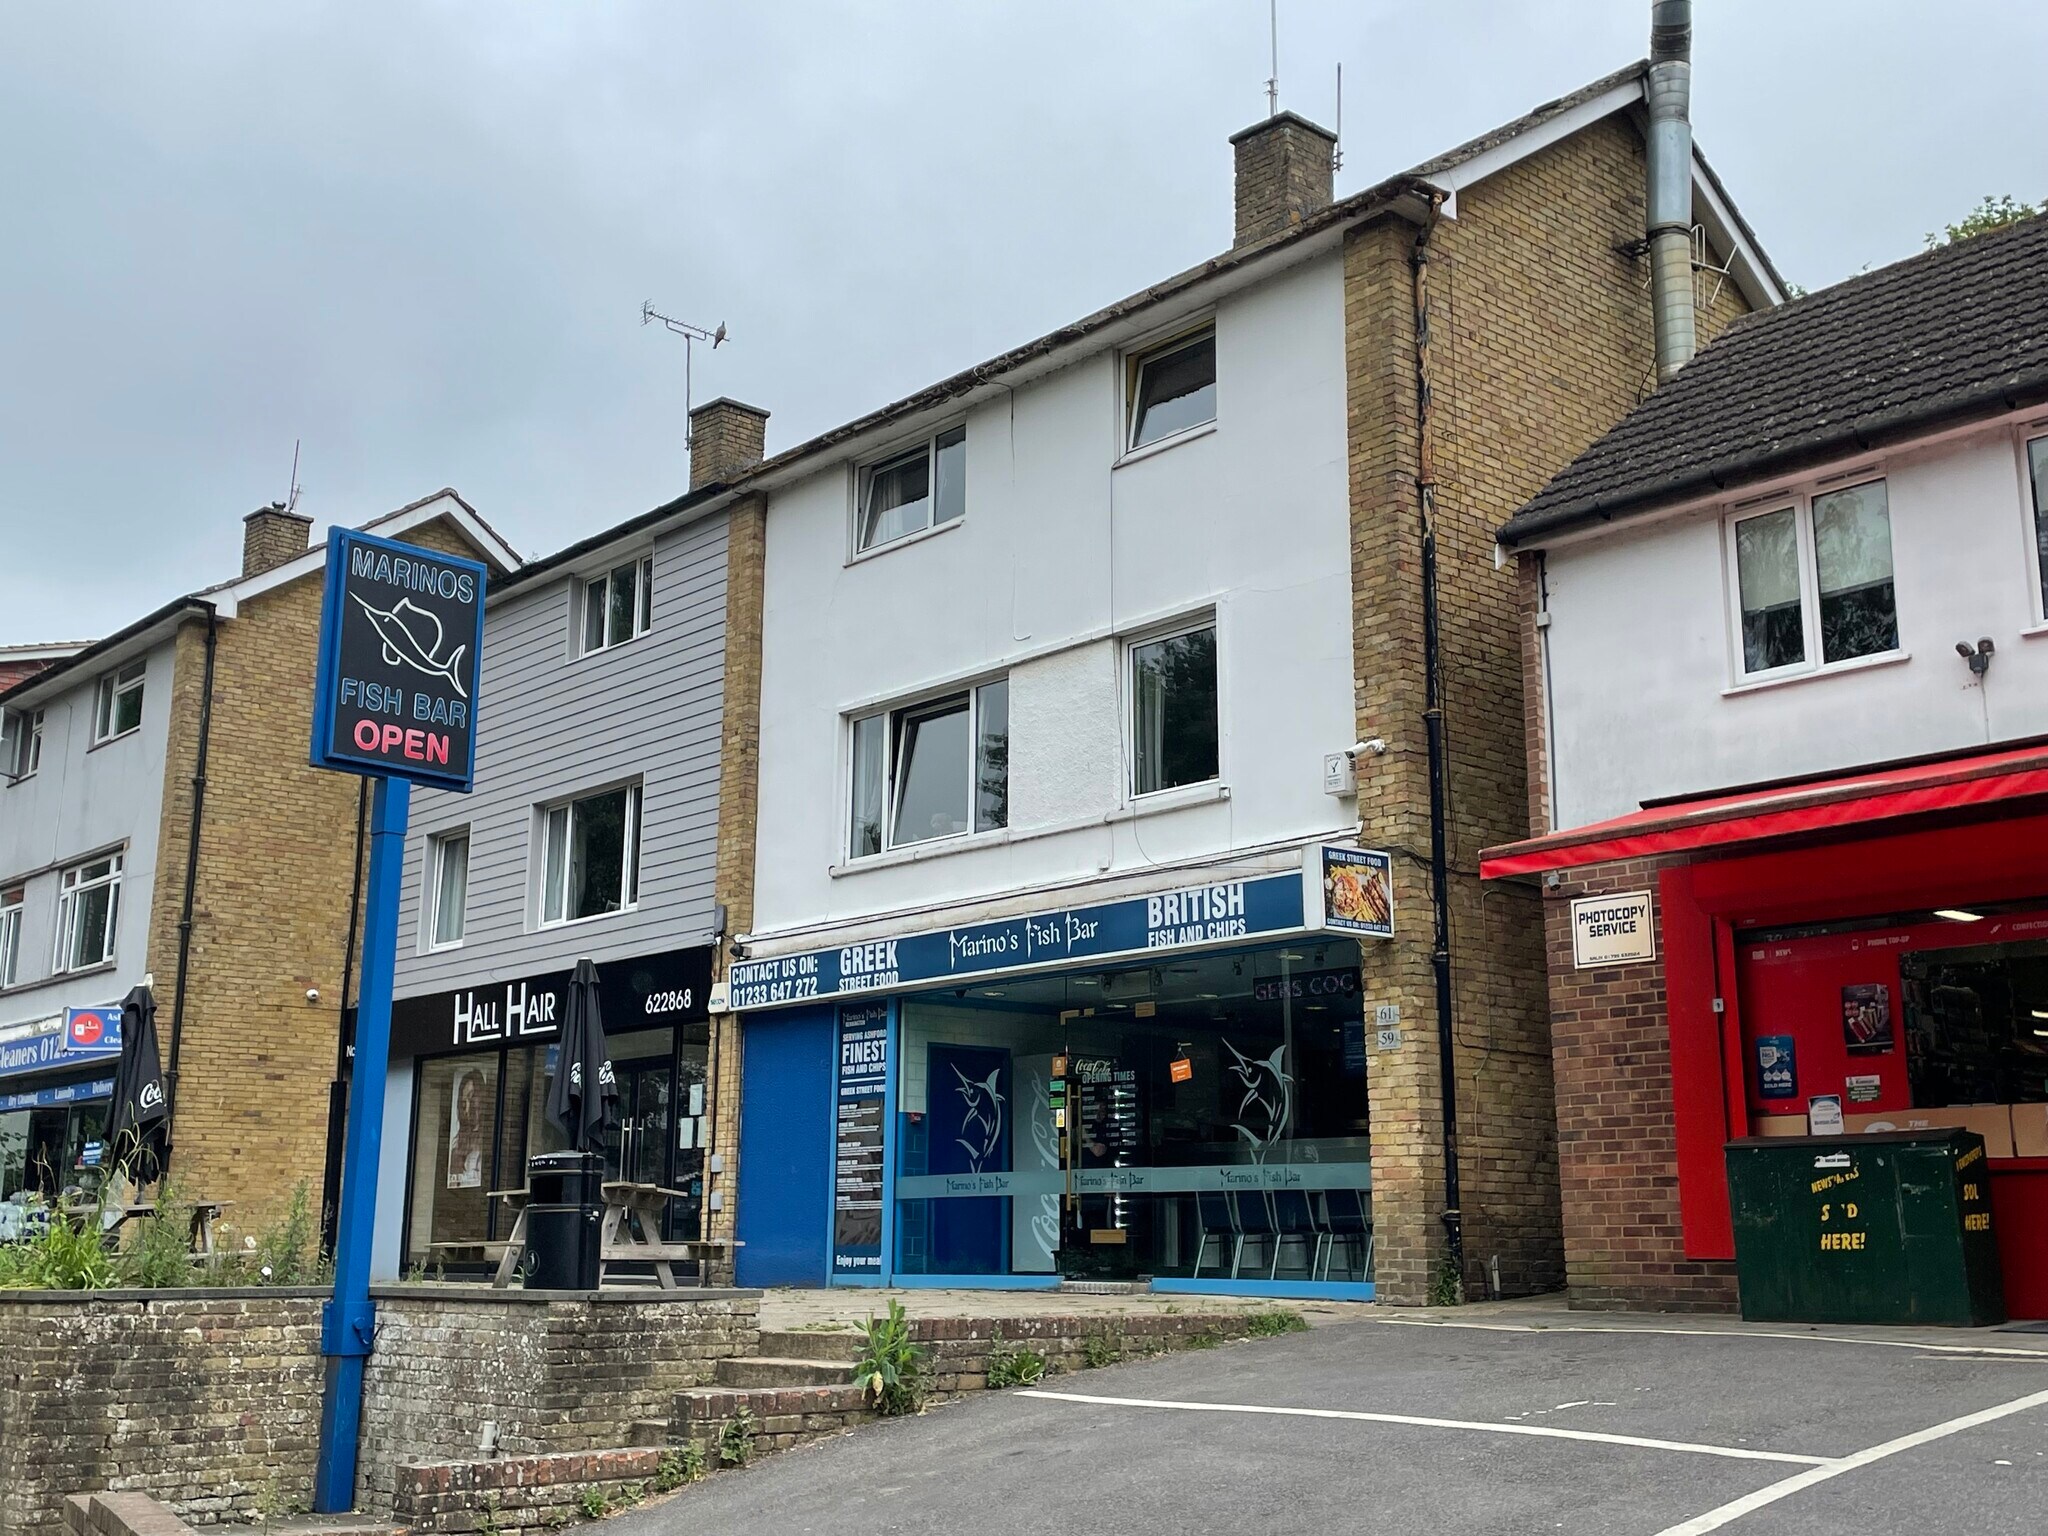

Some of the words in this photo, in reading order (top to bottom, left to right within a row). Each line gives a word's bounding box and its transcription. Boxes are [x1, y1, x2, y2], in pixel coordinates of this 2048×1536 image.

[351, 547, 474, 604] MARINOS
[341, 678, 403, 715] FISH
[413, 693, 467, 729] BAR
[354, 719, 450, 765] OPEN
[1328, 850, 1346, 862] GREEK
[1346, 853, 1366, 865] STREET
[1367, 855, 1382, 867] FOOD
[1147, 883, 1245, 929] BRITISH
[1578, 905, 1645, 925] PHOTOCOPY
[1148, 927, 1176, 948] FISH
[1178, 924, 1205, 944] AND
[1206, 918, 1246, 940] CHIPS
[1589, 921, 1636, 938] SERVICE
[949, 929, 1018, 971] Marino's
[1024, 917, 1060, 959] Fish
[1065, 911, 1099, 954] Bar
[839, 940, 899, 976] GREEK
[732, 962, 780, 985] CONTACT
[782, 959, 796, 977] US
[799, 955, 818, 974] ON:
[838, 975, 873, 992] STREET
[874, 971, 899, 987] FOOD
[732, 984, 767, 1007] 01233
[770, 980, 793, 1001] 647
[795, 976, 818, 996] 272
[453, 991, 502, 1045] HALL
[506, 982, 557, 1037] HAIR
[645, 988, 692, 1015] 622868
[1380, 1007, 1393, 1021] 61
[842, 1032, 863, 1042] SERVING
[1381, 1032, 1394, 1045] 59
[0, 1044, 38, 1069] leaners
[842, 1040, 887, 1064] FINEST
[842, 1065, 855, 1076] FISH
[856, 1063, 868, 1074] AND
[868, 1062, 886, 1072] CHIPS
[1082, 1073, 1112, 1084] OPENING
[1114, 1070, 1135, 1082] TIMES
[856, 1086, 873, 1094] STREET
[978, 1175, 994, 1192] Fish
[995, 1174, 1010, 1192] Bar
[1128, 1170, 1144, 1188] Bar
[1284, 1166, 1302, 1185] Bar
[1964, 1213, 1990, 1231] HERE!
[1820, 1232, 1866, 1250] HERE!
[836, 1254, 852, 1268] Enjoy
[853, 1256, 866, 1268] your
